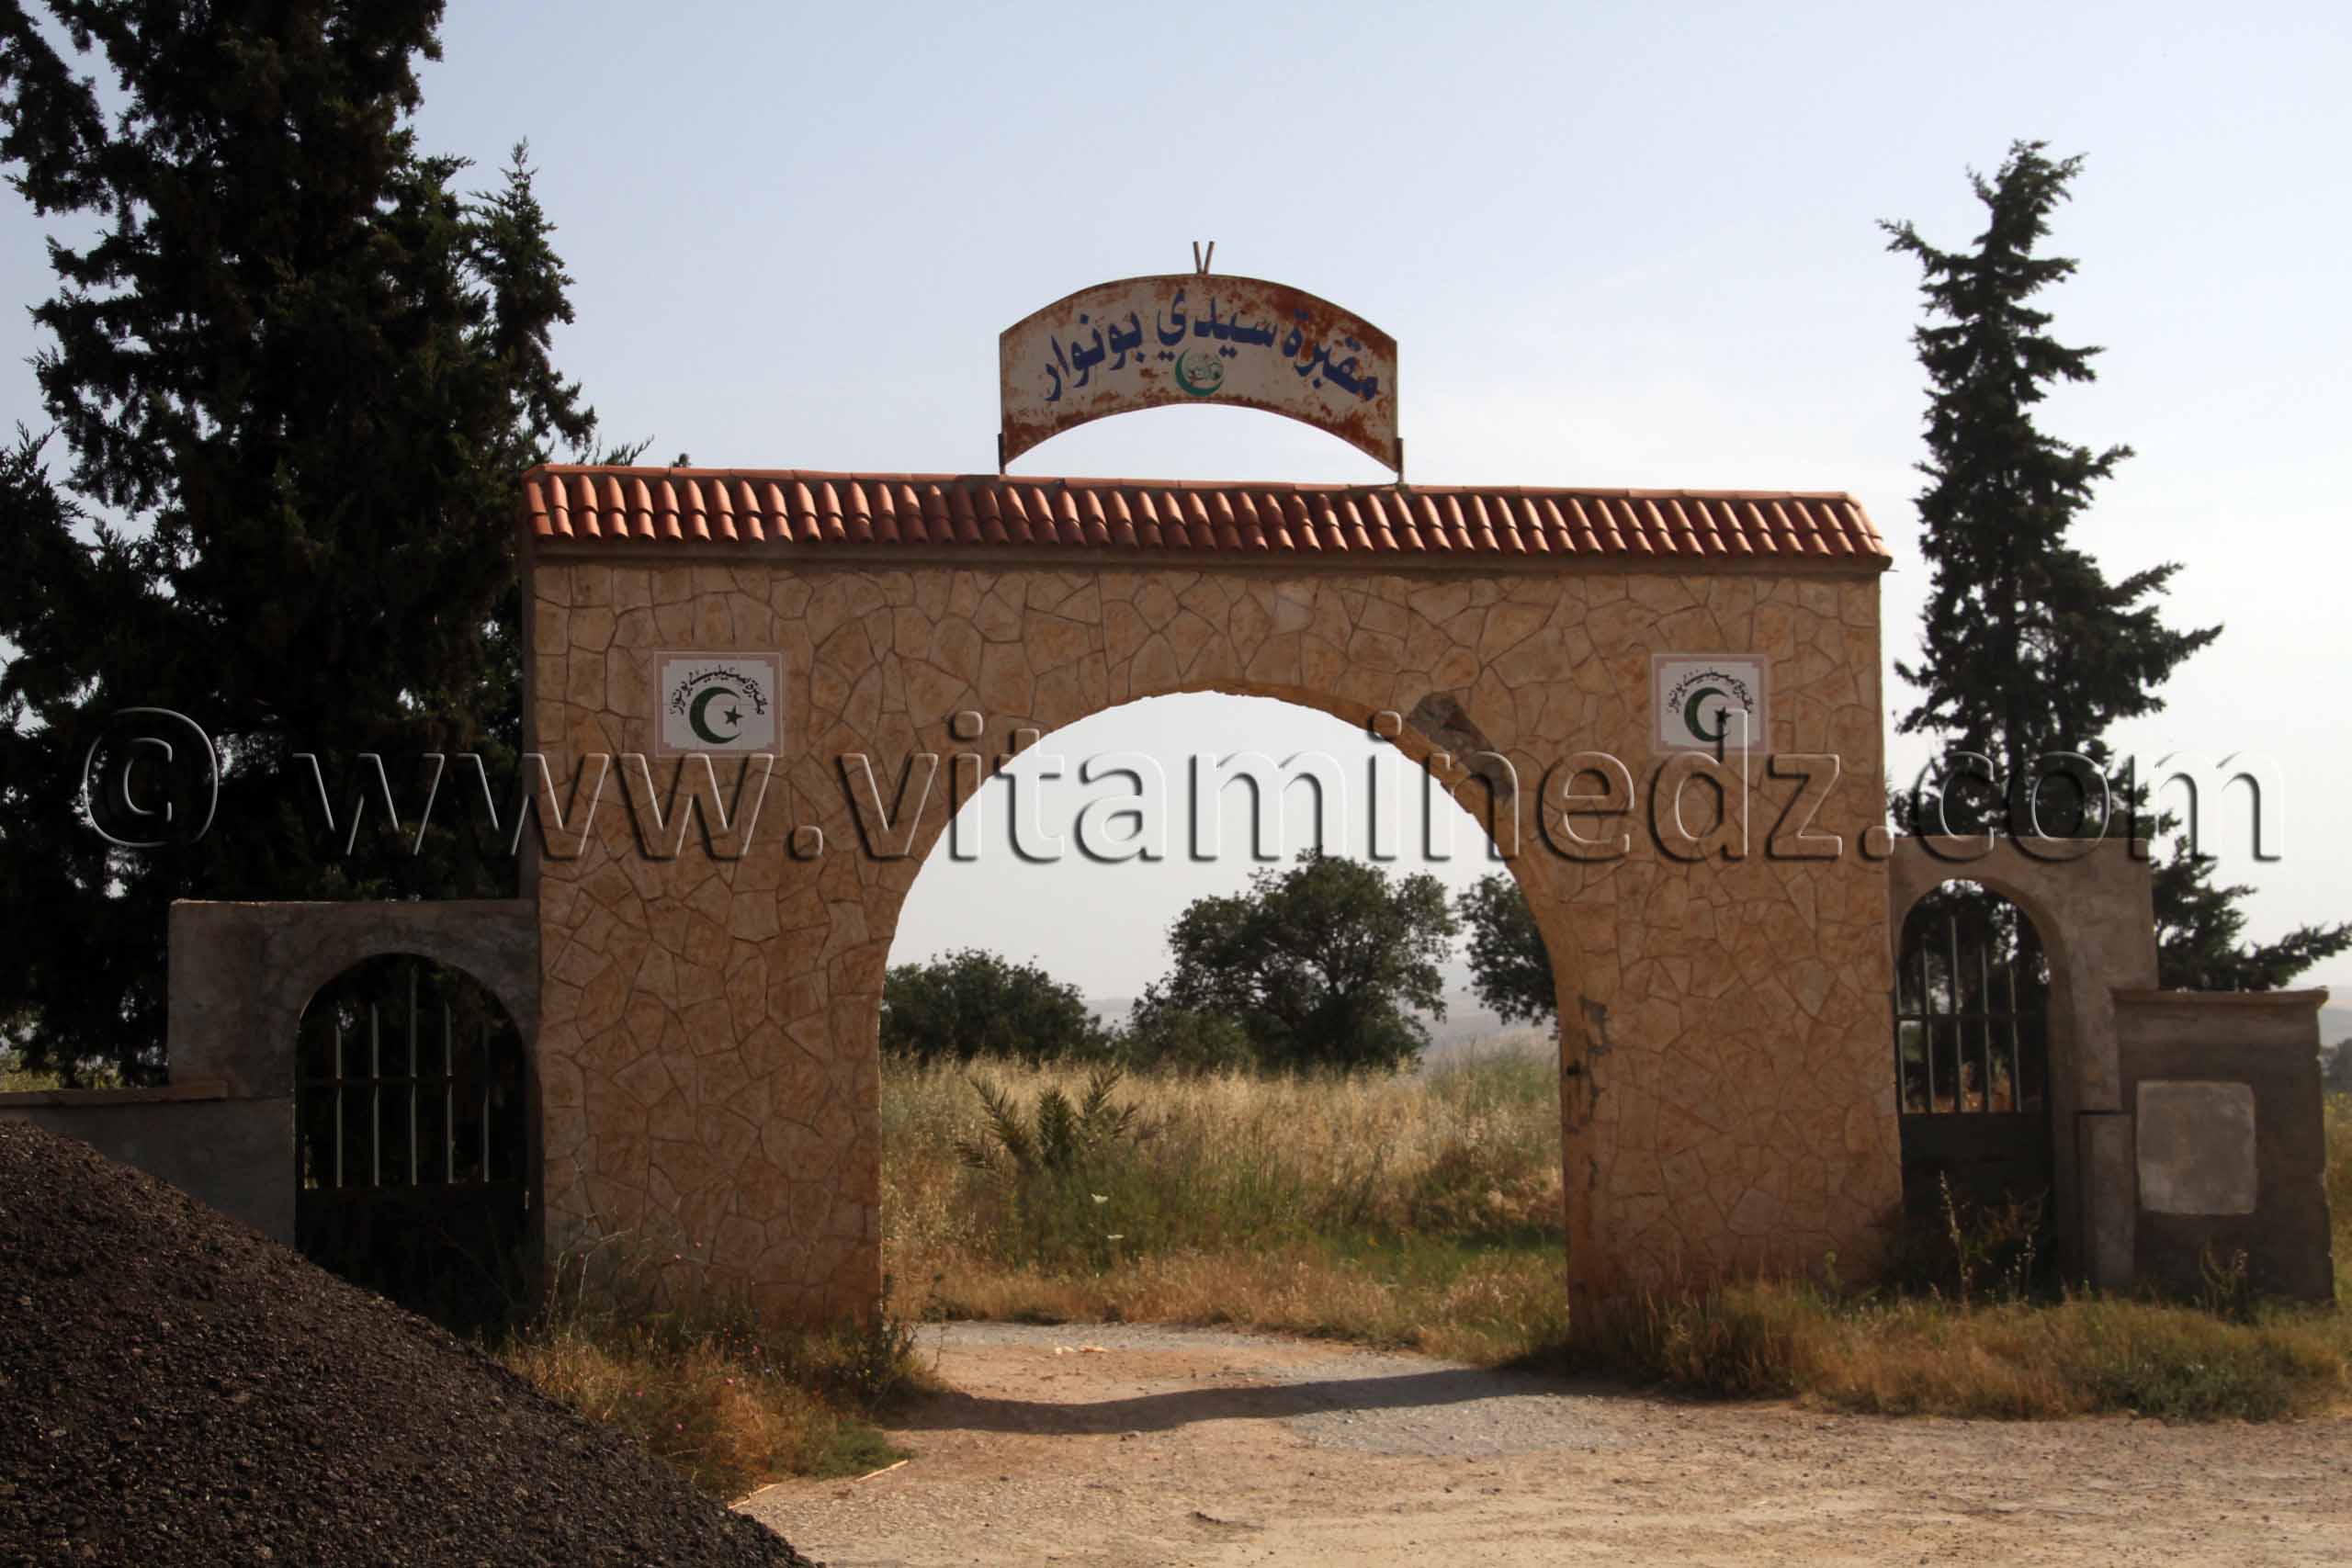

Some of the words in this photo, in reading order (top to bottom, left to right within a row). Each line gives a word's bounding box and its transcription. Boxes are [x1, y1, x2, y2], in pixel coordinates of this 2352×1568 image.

[1044, 311, 1143, 401] بونوار
[1156, 288, 1278, 362] سيدي
[1282, 308, 1379, 401] مقبرة
